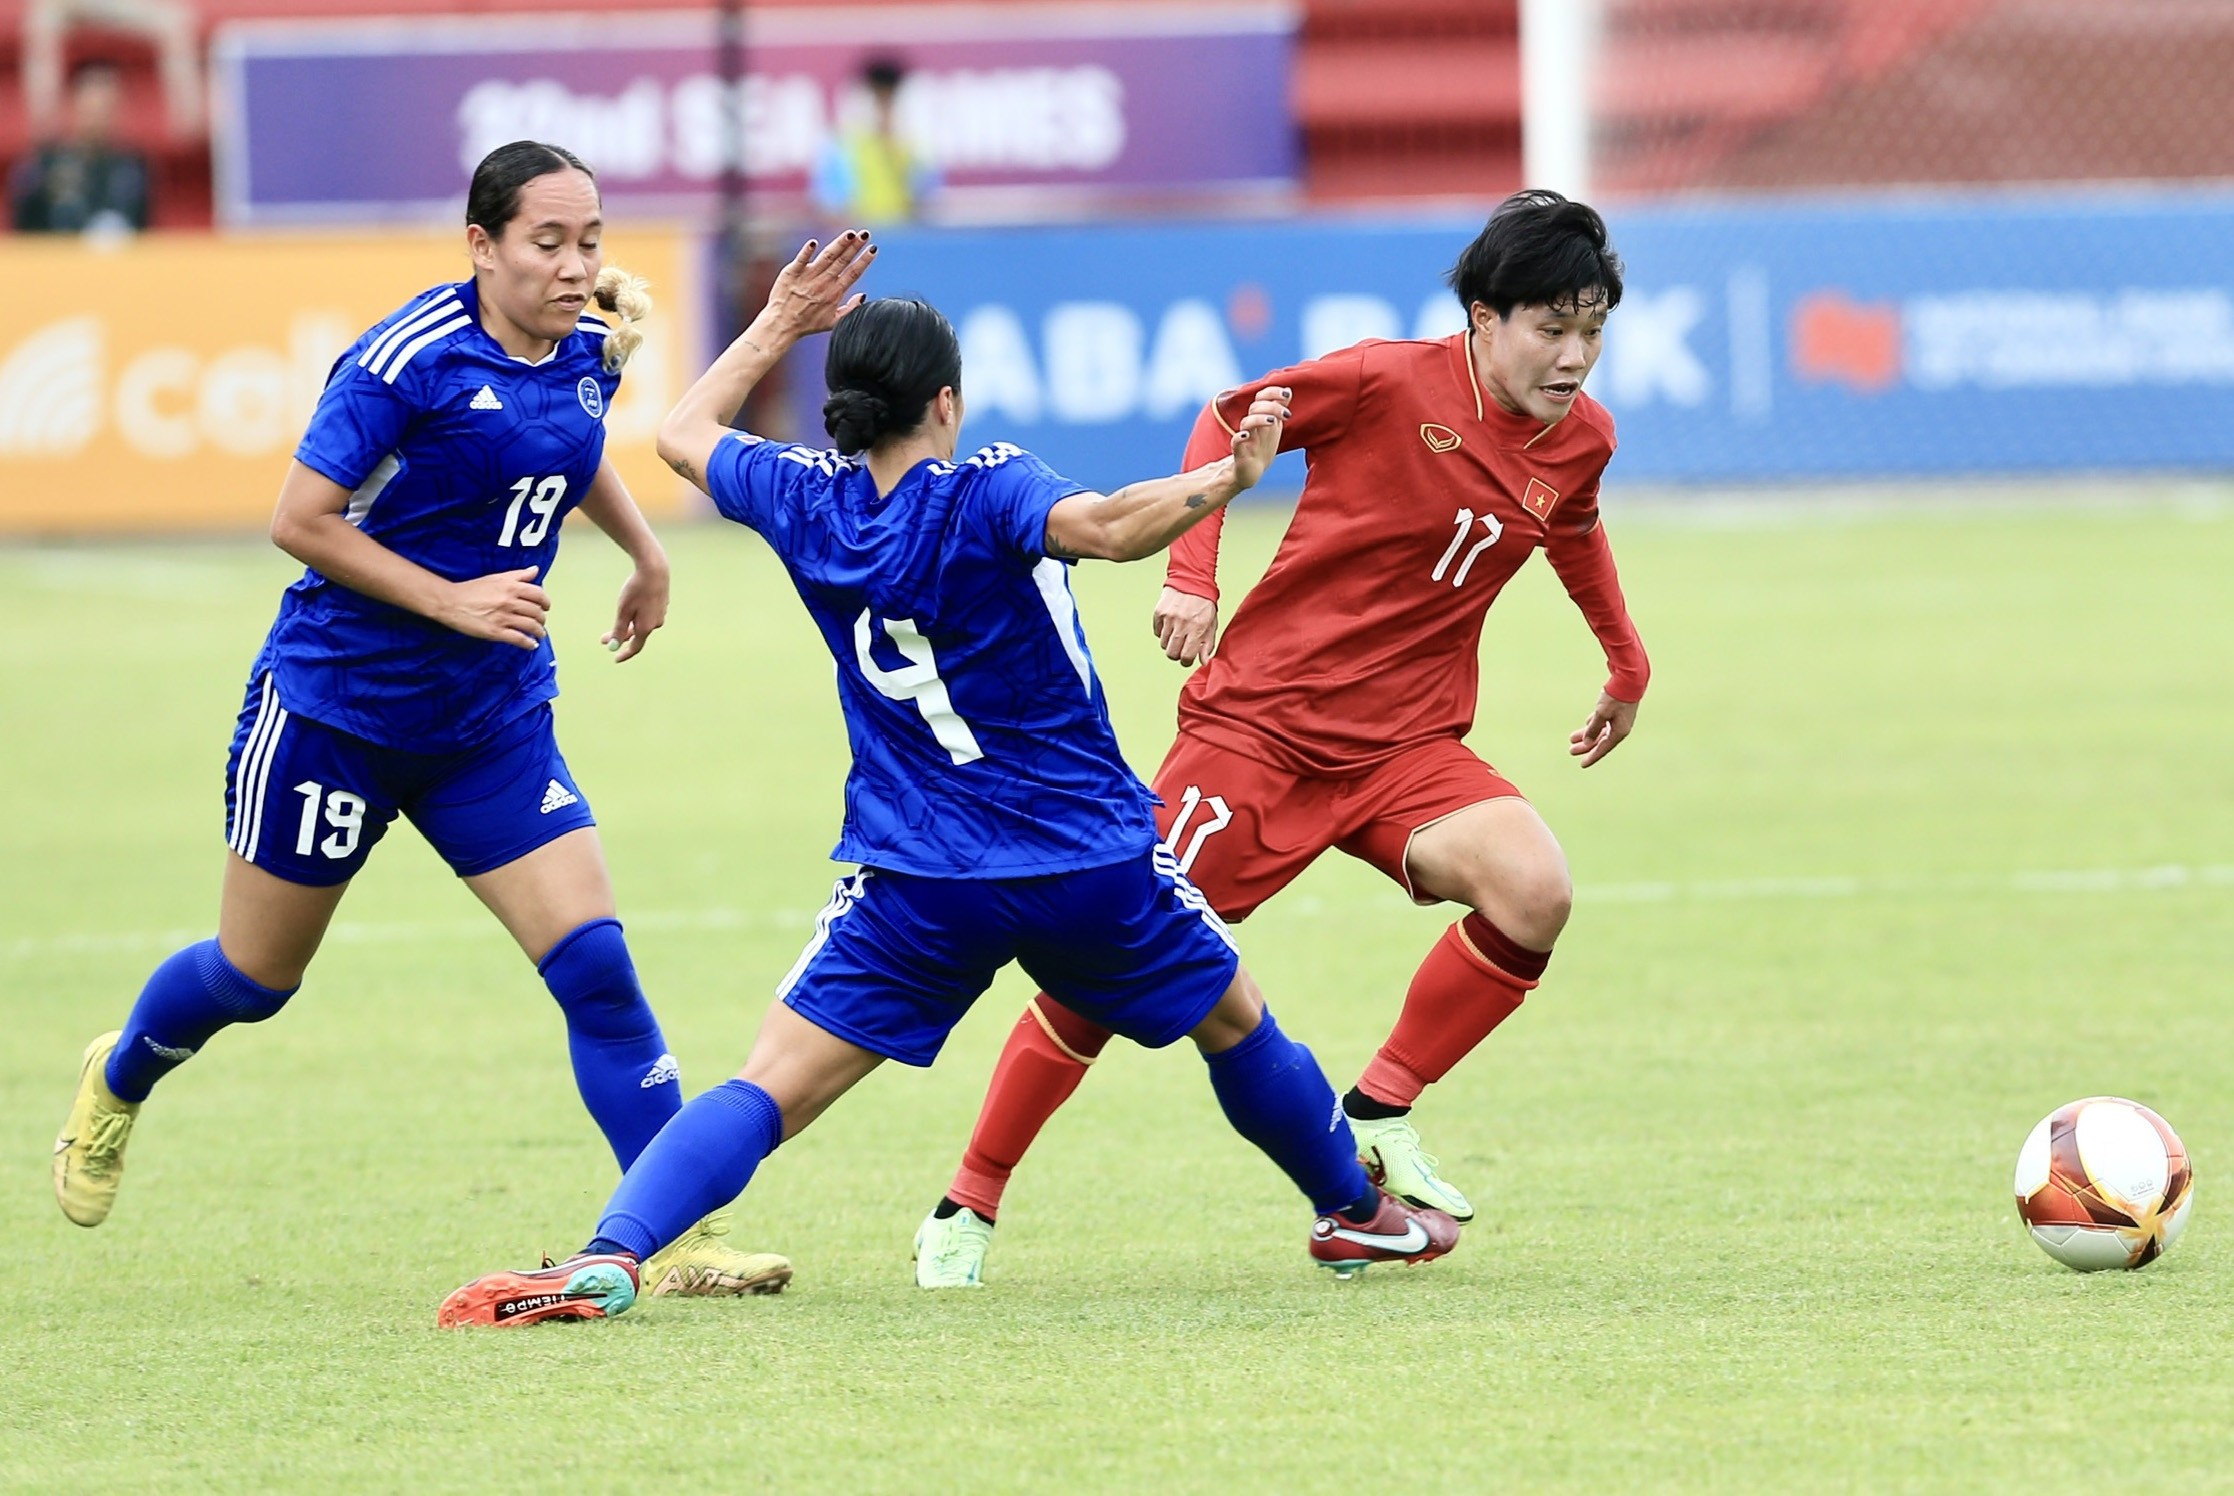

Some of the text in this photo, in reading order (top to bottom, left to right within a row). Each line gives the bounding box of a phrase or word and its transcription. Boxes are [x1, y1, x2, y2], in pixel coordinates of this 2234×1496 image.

[671, 75, 822, 176] SEA
[498, 475, 568, 547] 19
[1431, 508, 1504, 588] 17
[854, 606, 985, 766] 4
[293, 780, 366, 859] 19
[540, 793, 578, 814] adidas
[1164, 785, 1233, 875] 17
